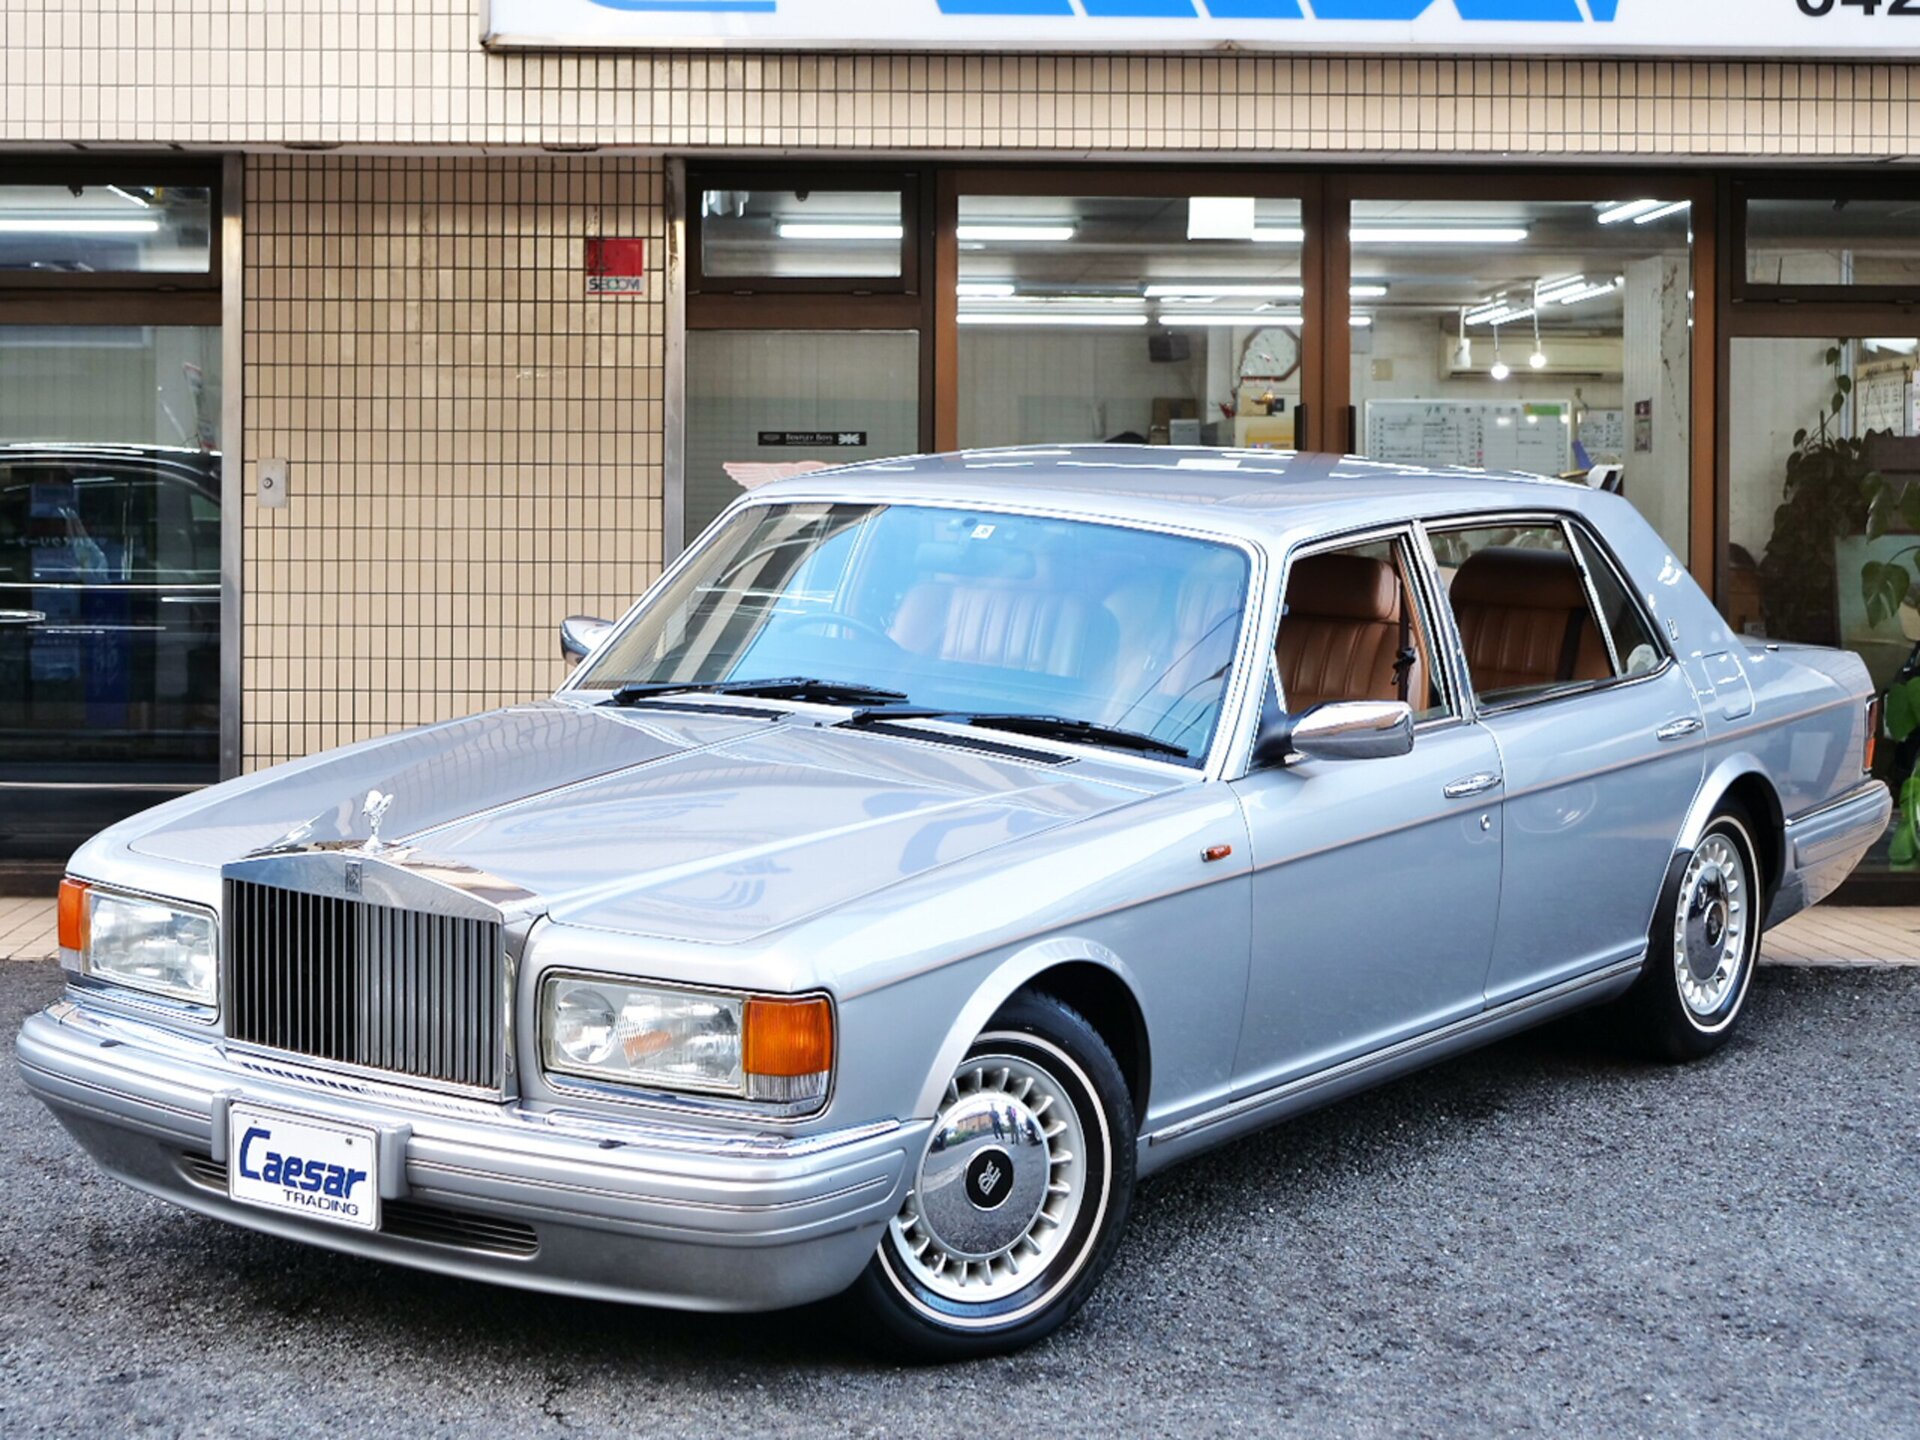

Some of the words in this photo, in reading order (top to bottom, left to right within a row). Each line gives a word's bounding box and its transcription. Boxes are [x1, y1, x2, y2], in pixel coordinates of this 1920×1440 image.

[589, 278, 640, 290] SECOM
[239, 1127, 366, 1199] Caesar
[283, 1189, 359, 1216] TRADING
